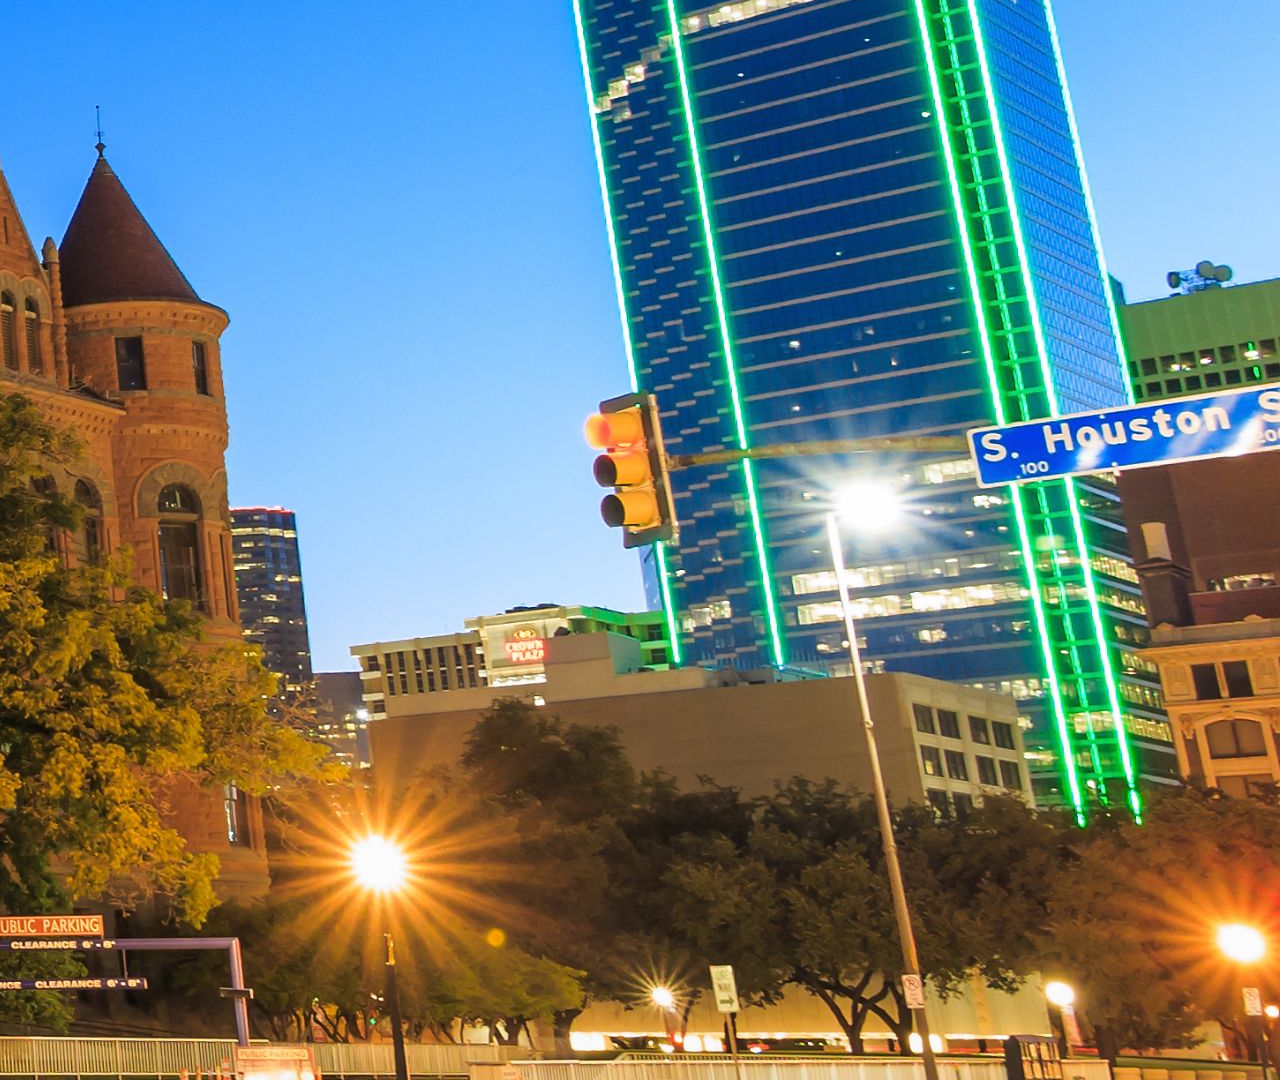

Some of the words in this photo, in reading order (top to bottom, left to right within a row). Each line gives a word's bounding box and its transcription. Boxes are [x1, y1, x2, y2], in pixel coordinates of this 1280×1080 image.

[981, 433, 1019, 462] S.
[1043, 408, 1231, 454] Houston
[1019, 461, 1049, 475] 100
[43, 918, 101, 933] PARKING
[10, 940, 78, 950] CLEARANCE
[34, 979, 102, 989] CLEARANCE
